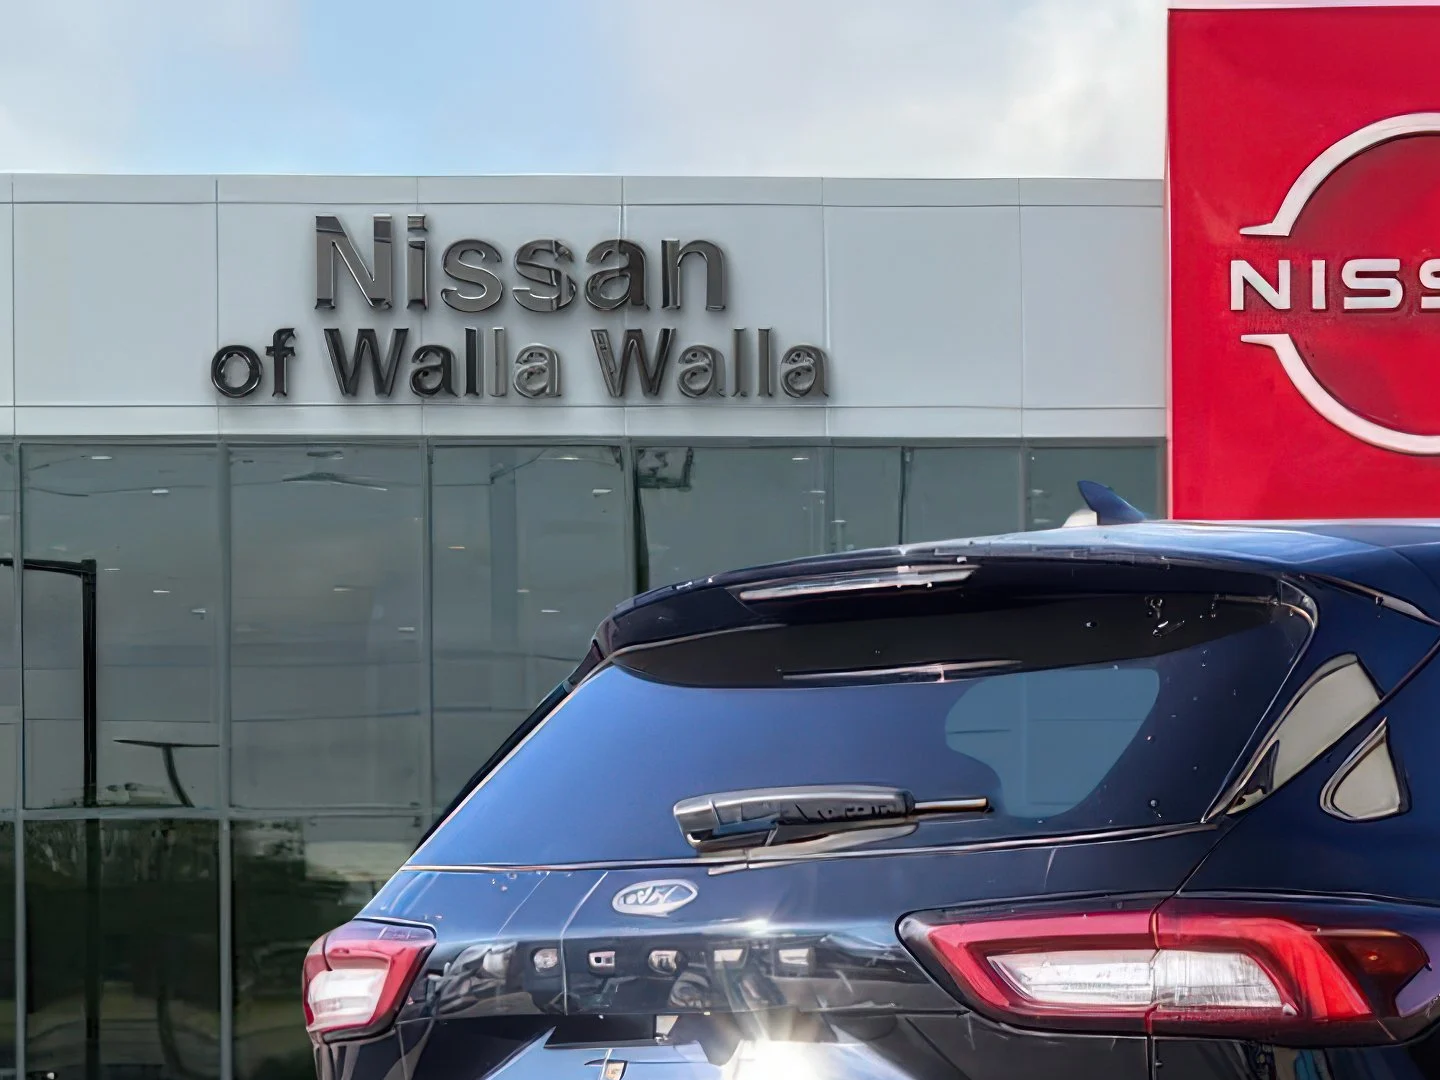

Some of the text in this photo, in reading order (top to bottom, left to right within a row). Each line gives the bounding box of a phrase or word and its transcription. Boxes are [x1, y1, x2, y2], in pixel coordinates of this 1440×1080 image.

[315, 214, 726, 312] Nissan
[210, 327, 830, 399] of Walla Walla
